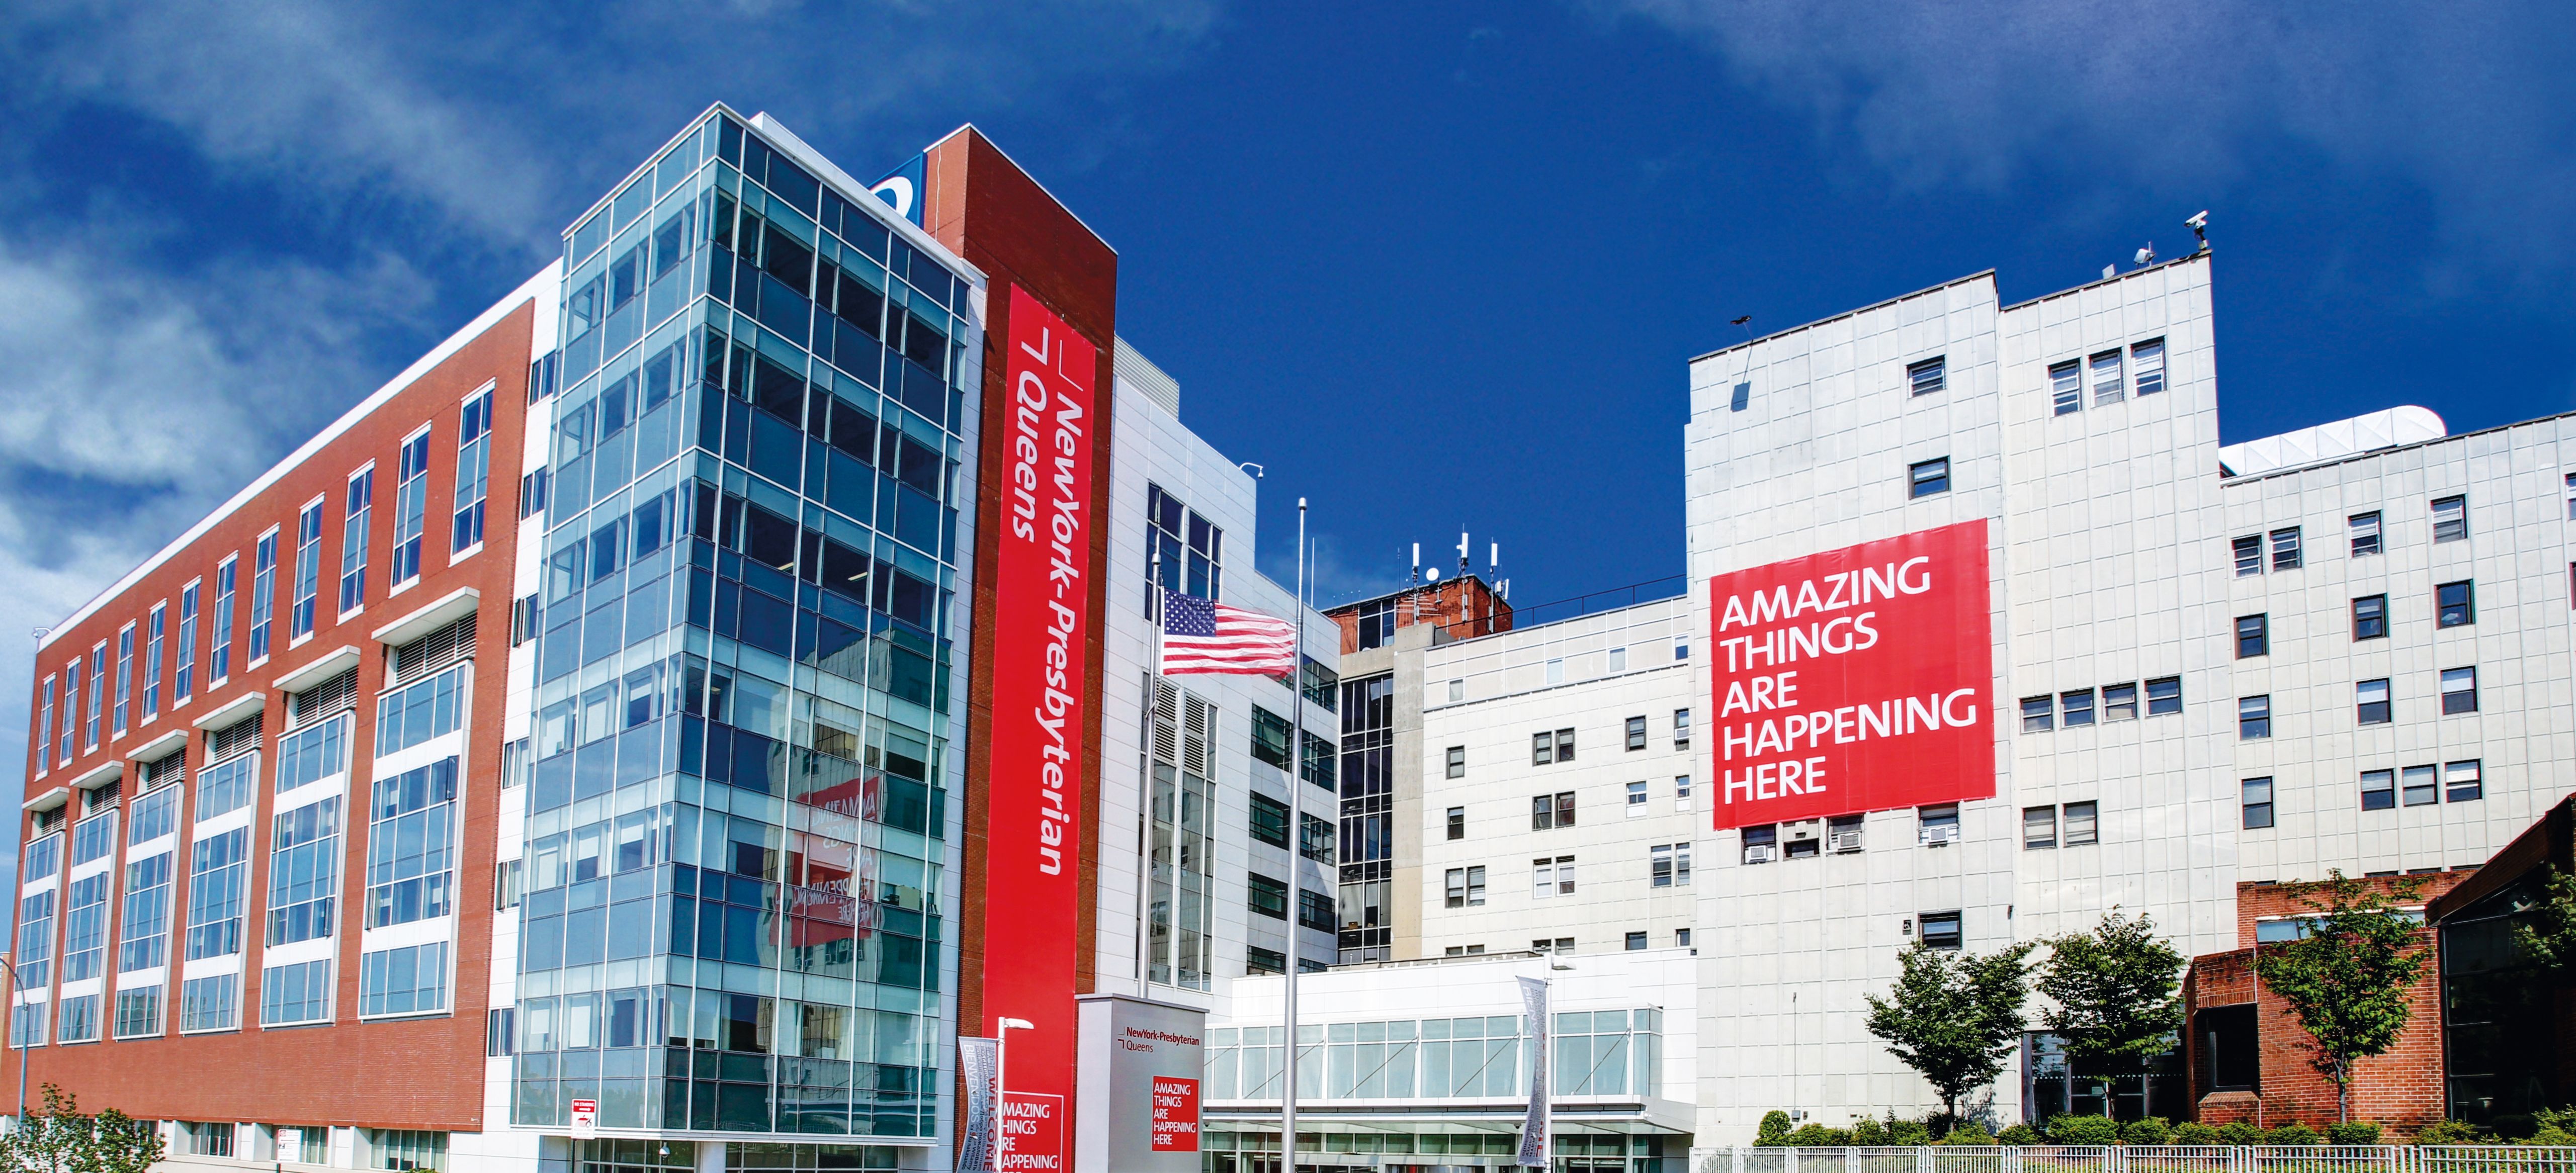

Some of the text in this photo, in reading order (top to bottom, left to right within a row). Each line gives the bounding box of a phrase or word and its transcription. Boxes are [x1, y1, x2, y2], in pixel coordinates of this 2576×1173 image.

[1012, 370, 1047, 544] Queens
[1719, 556, 1930, 632] AMAZING
[1035, 391, 1083, 875] NewYork-Presbyterian
[1720, 611, 1878, 673] THINGS
[1721, 671, 1797, 718] ARE
[1724, 688, 1976, 761] HAPPENING
[1725, 756, 1826, 804] HERE
[1126, 1040, 1153, 1052] Queens
[1127, 1027, 1199, 1046] NewYork-Presbyterian
[964, 1044, 980, 1123] BIENVENIDOS
[1154, 1082, 1190, 1095] AMAZING
[996, 1102, 1050, 1118] MAZING
[1154, 1095, 1182, 1107] THINGS
[1154, 1108, 1168, 1119] ARE
[983, 1077, 995, 1171] WELCOME
[996, 1119, 1037, 1134] HINGS
[1154, 1121, 1196, 1133] HAPPENING
[972, 1132, 982, 1171] пожаловать
[996, 1137, 1016, 1151] RE
[1154, 1134, 1172, 1145] HERE
